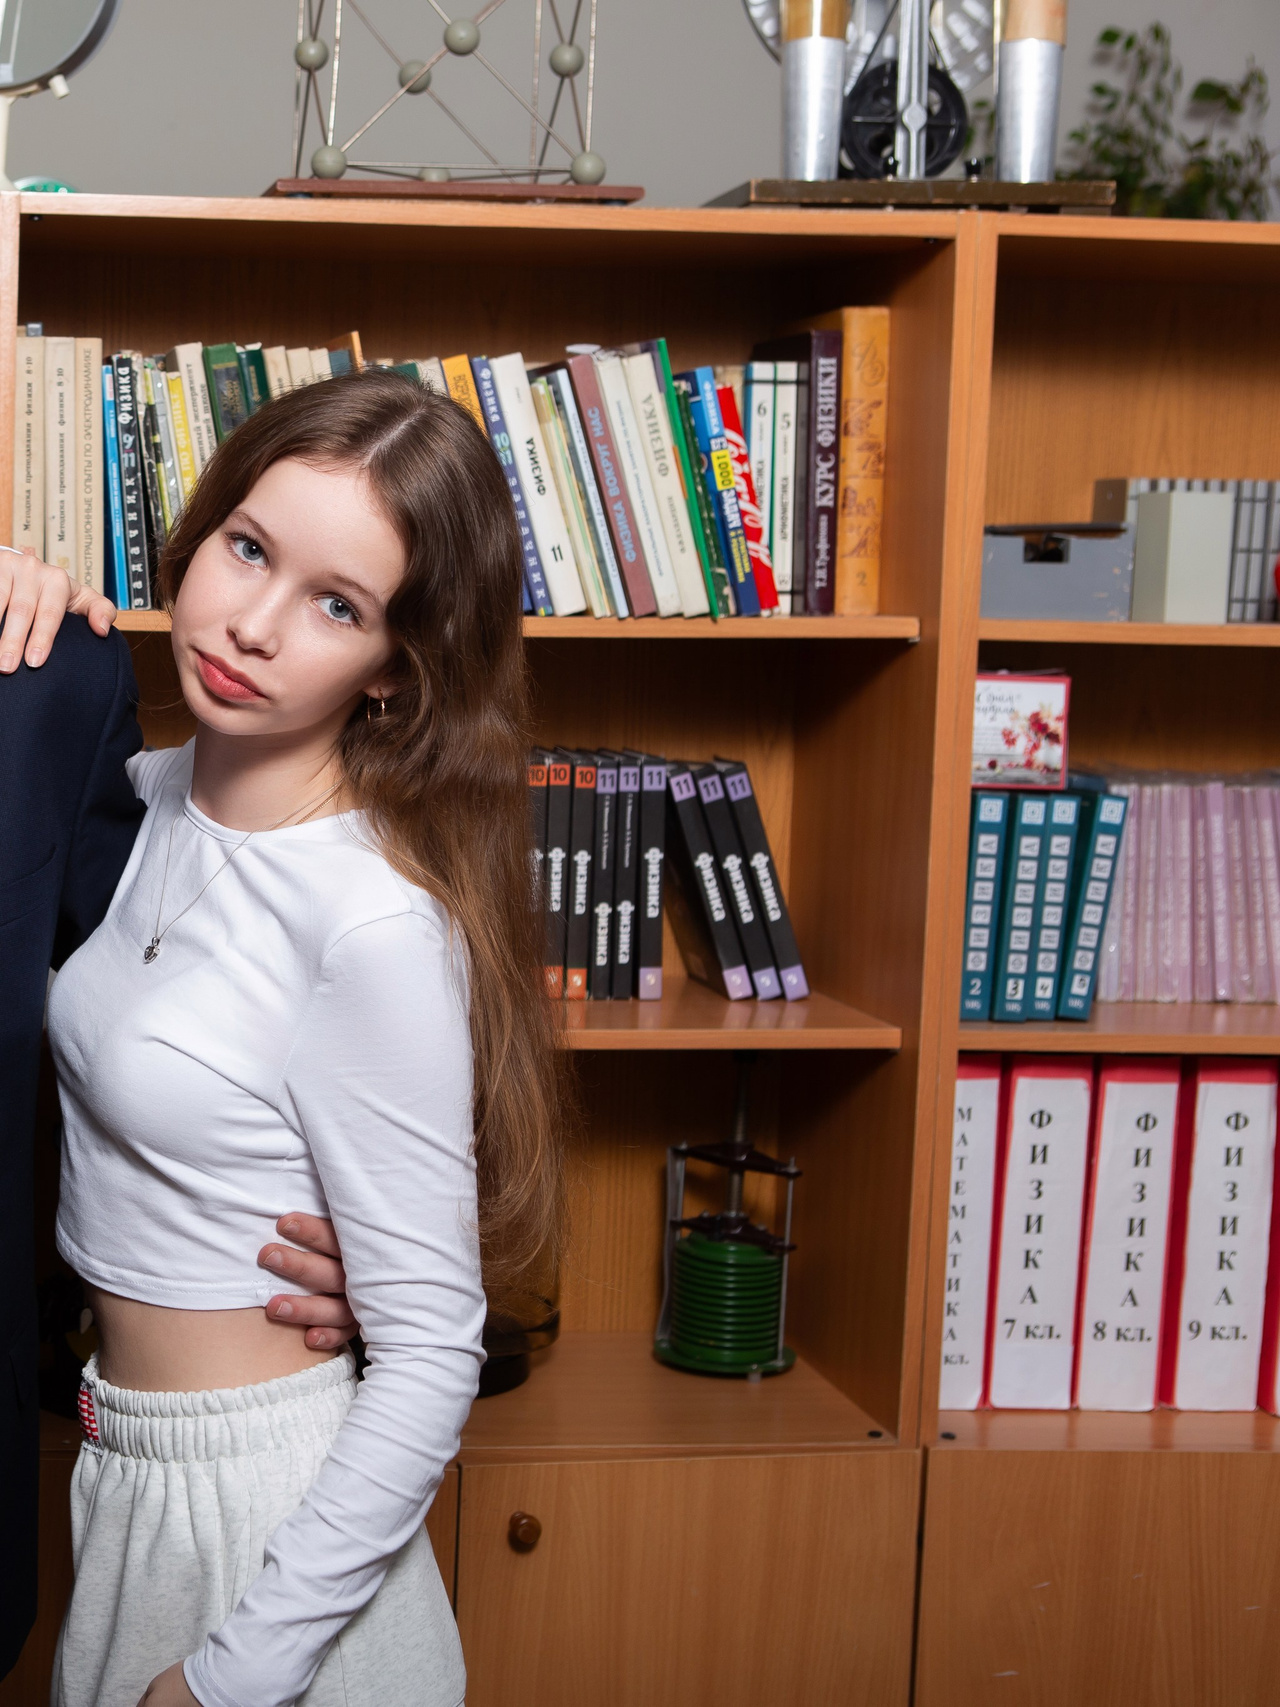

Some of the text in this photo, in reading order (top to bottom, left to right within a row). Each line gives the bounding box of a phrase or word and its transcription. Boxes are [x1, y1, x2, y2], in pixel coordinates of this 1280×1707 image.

[25, 382, 34, 416] физики
[58, 392, 66, 426] физики
[83, 348, 94, 441] ЭЛЕКТРОДИНАМИКЕ
[116, 365, 135, 425] Физика
[185, 362, 200, 423] эксперимент
[200, 383, 210, 415] школе
[480, 367, 501, 423] Физика
[703, 380, 720, 436] ФИЗИКА
[757, 401, 768, 418] 6
[816, 356, 838, 448] ФИЗИКИ
[586, 405, 605, 438] НАС
[641, 393, 670, 477] ФИЗИКА
[25, 422, 33, 484] преподавания
[58, 432, 67, 494] преподавания
[83, 443, 93, 458] ПО
[525, 436, 547, 496] ФИЗИКА
[83, 459, 94, 494] ОПЫТЫ
[595, 441, 620, 498] ВОКРУГ
[716, 454, 733, 487] 1000
[816, 452, 835, 508] КУРС
[22, 489, 32, 531] Методика
[57, 500, 66, 542] Методика
[721, 488, 742, 529] ЗАДАЧ
[612, 500, 637, 563] ФИЗИКА
[550, 543, 564, 562] 11
[553, 767, 567, 781] 10
[579, 770, 594, 784] 10
[600, 773, 615, 788] 11
[624, 771, 638, 787] 11
[647, 771, 664, 787] 11
[675, 778, 692, 796] 11
[702, 780, 719, 798] 11
[730, 778, 747, 796] 11
[969, 977, 982, 996] 2
[943, 1107, 973, 1341] МАТЕМАТИКА
[1020, 1109, 1054, 1305] ФИЗИКА
[1120, 1112, 1158, 1307] ФИЗИКА
[1215, 1111, 1250, 1306] ФИЗИКА
[1004, 1318, 1062, 1340] 7 кл.
[1092, 1321, 1152, 1342] 8 кл.
[1188, 1320, 1248, 1341] 9 кл.
